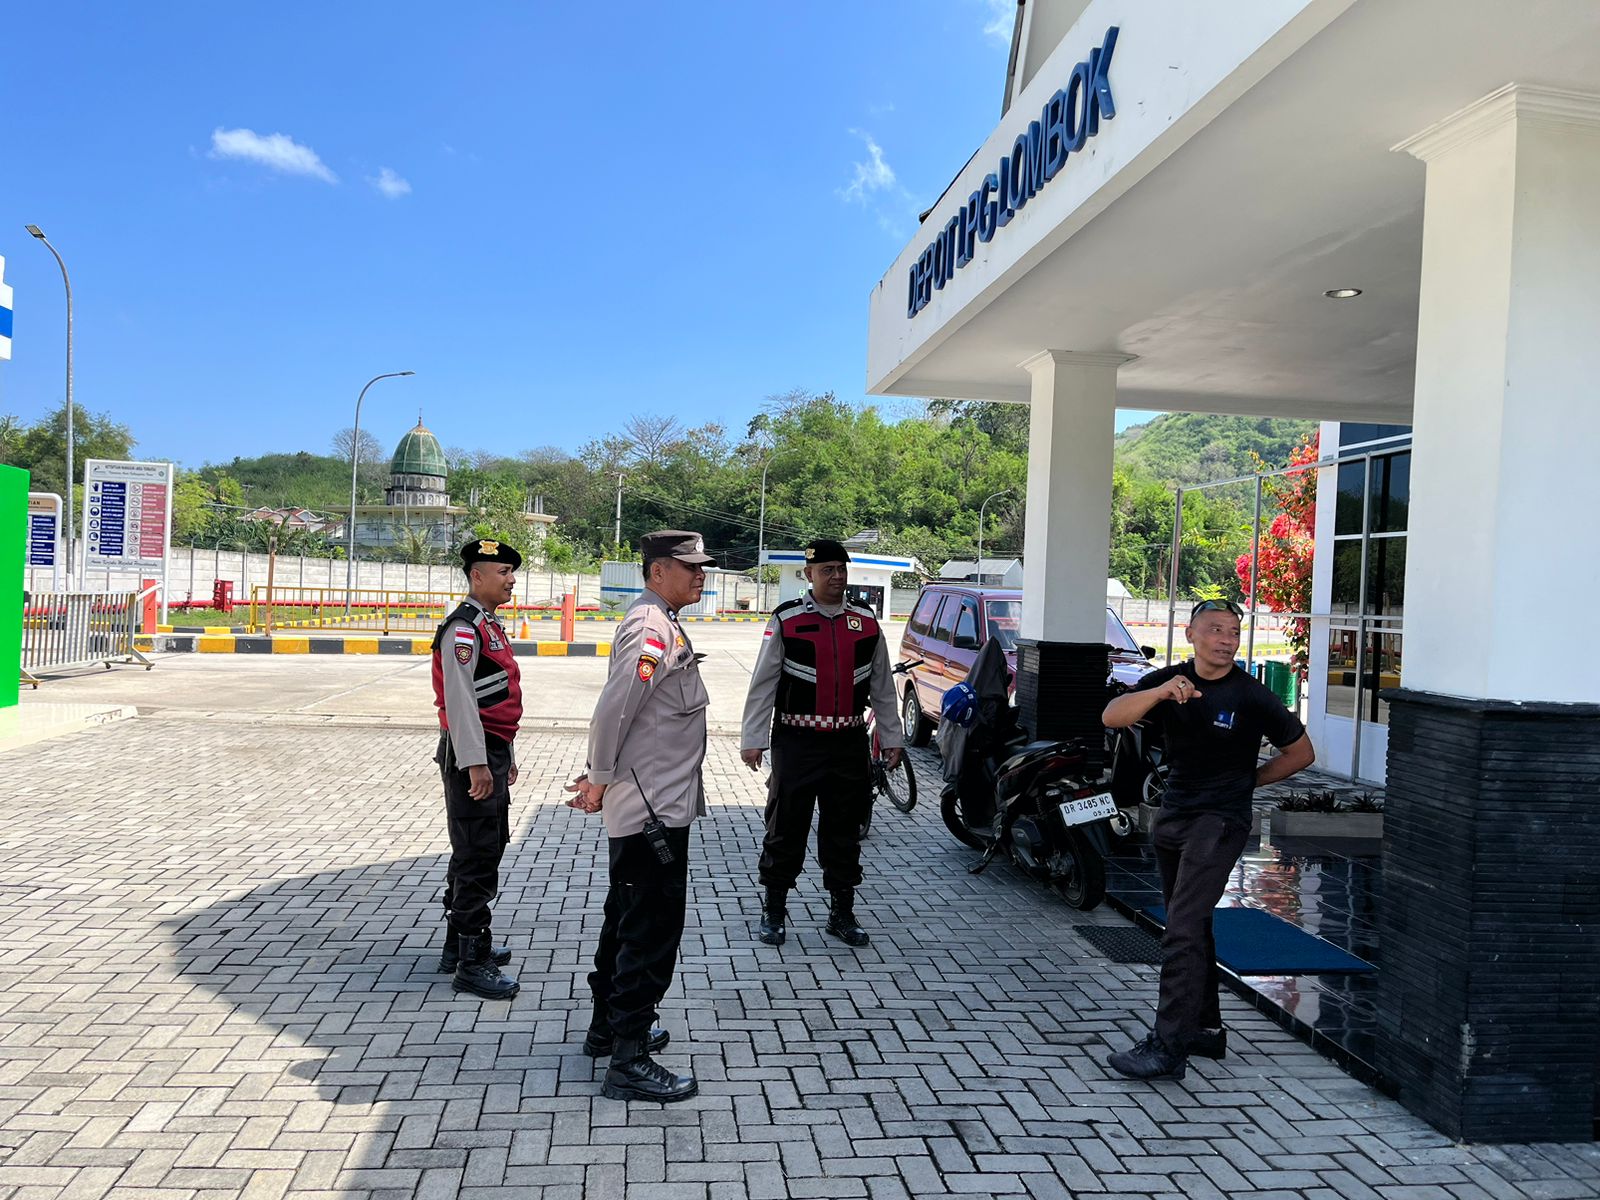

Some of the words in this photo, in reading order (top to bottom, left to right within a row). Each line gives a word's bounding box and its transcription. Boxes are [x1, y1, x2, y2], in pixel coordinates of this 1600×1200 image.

[907, 216, 958, 319] DEPOT
[956, 173, 998, 269] LPG
[997, 26, 1120, 227] LOMBOK
[1063, 803, 1077, 814] DR
[1077, 798, 1098, 811] 3485
[1098, 795, 1111, 806] NC
